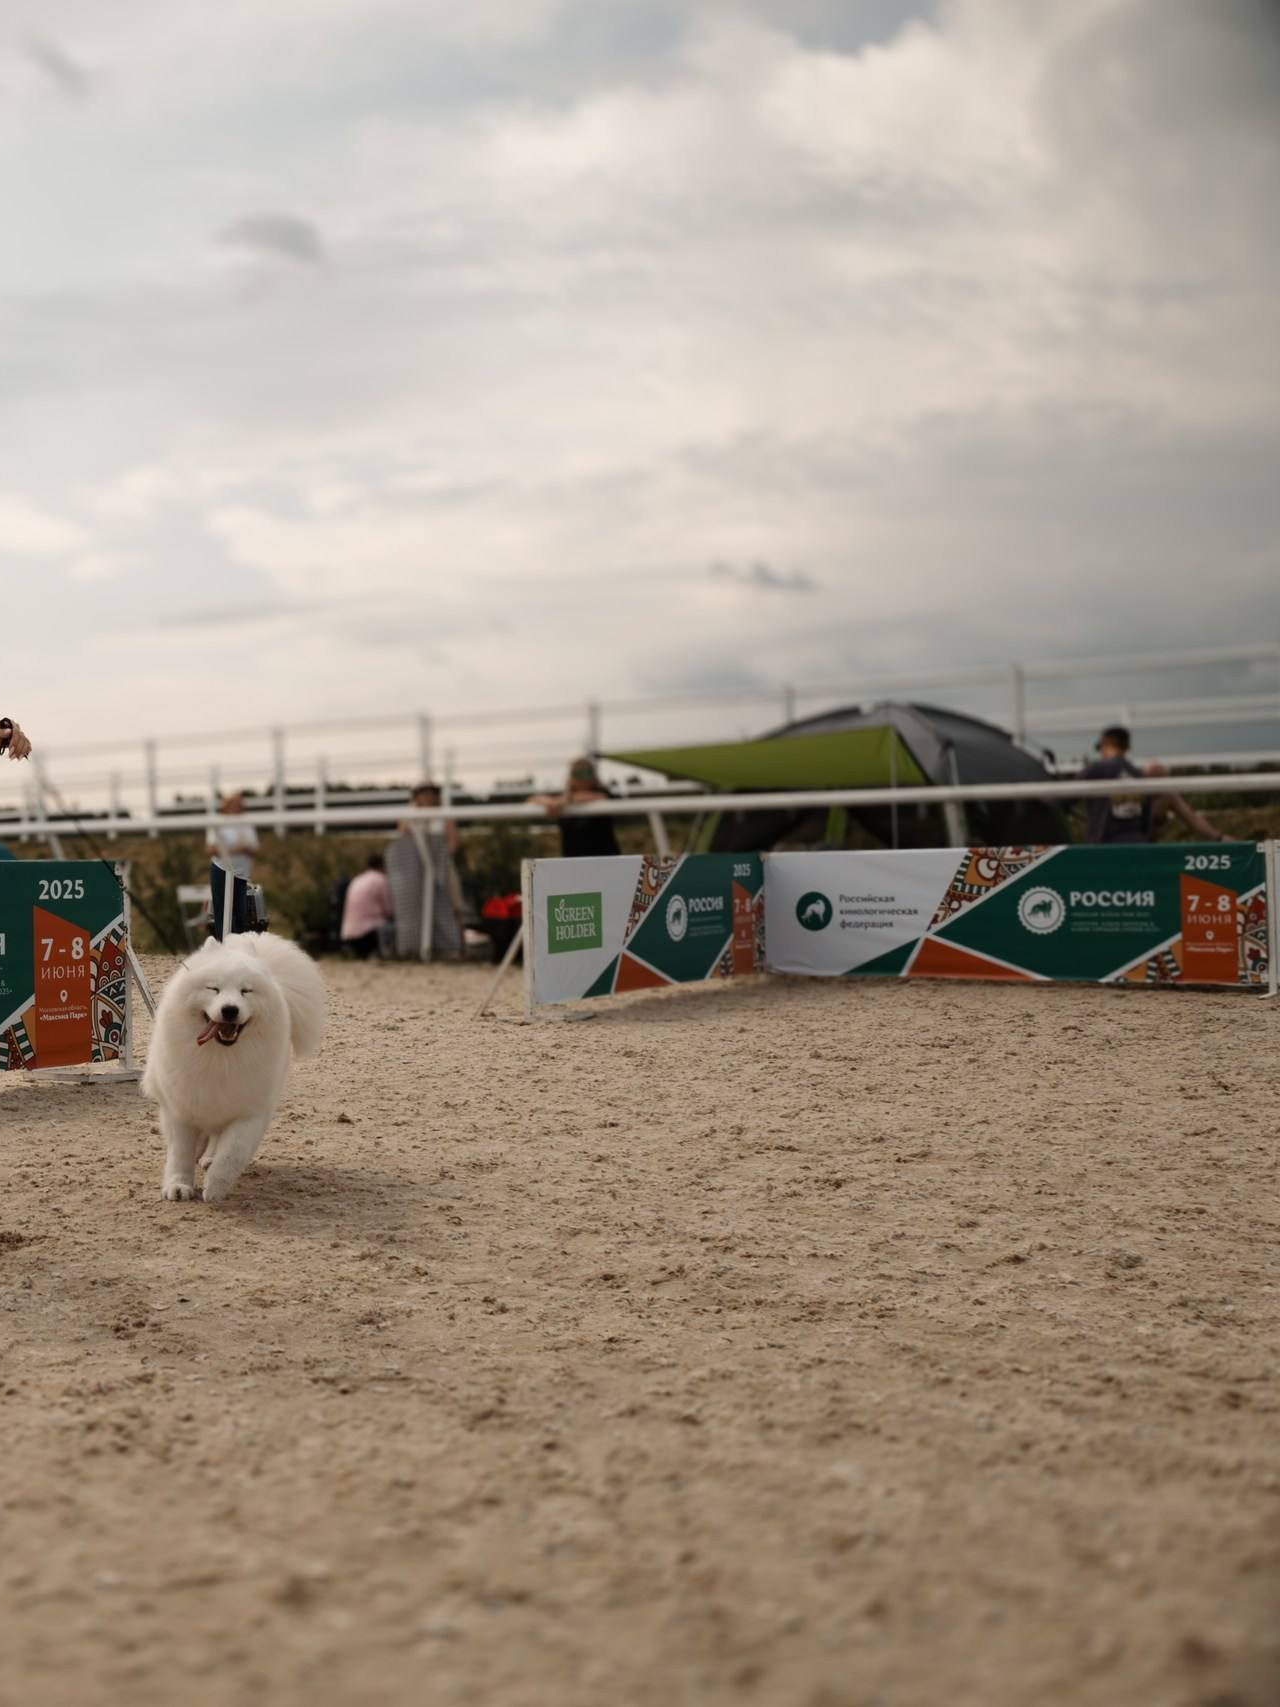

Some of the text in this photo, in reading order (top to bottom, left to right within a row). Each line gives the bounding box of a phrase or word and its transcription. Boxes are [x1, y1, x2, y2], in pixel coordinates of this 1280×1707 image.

[733, 863, 751, 877] 2025
[1184, 855, 1231, 870] 2025
[39, 879, 85, 900] 2025
[689, 896, 724, 913] РОССИЯ
[839, 894, 895, 903] Российская
[1070, 890, 1155, 907] РОССИЯ
[1187, 895, 1200, 912] 7
[1217, 895, 1231, 912] 8
[563, 906, 595, 922] GREEN
[840, 908, 918, 916] кинологическая
[556, 922, 597, 940] HOLDER
[840, 920, 893, 929] федерация
[41, 938, 54, 961] 7
[71, 937, 84, 960] 8
[41, 965, 85, 980] ИЮНЯ
